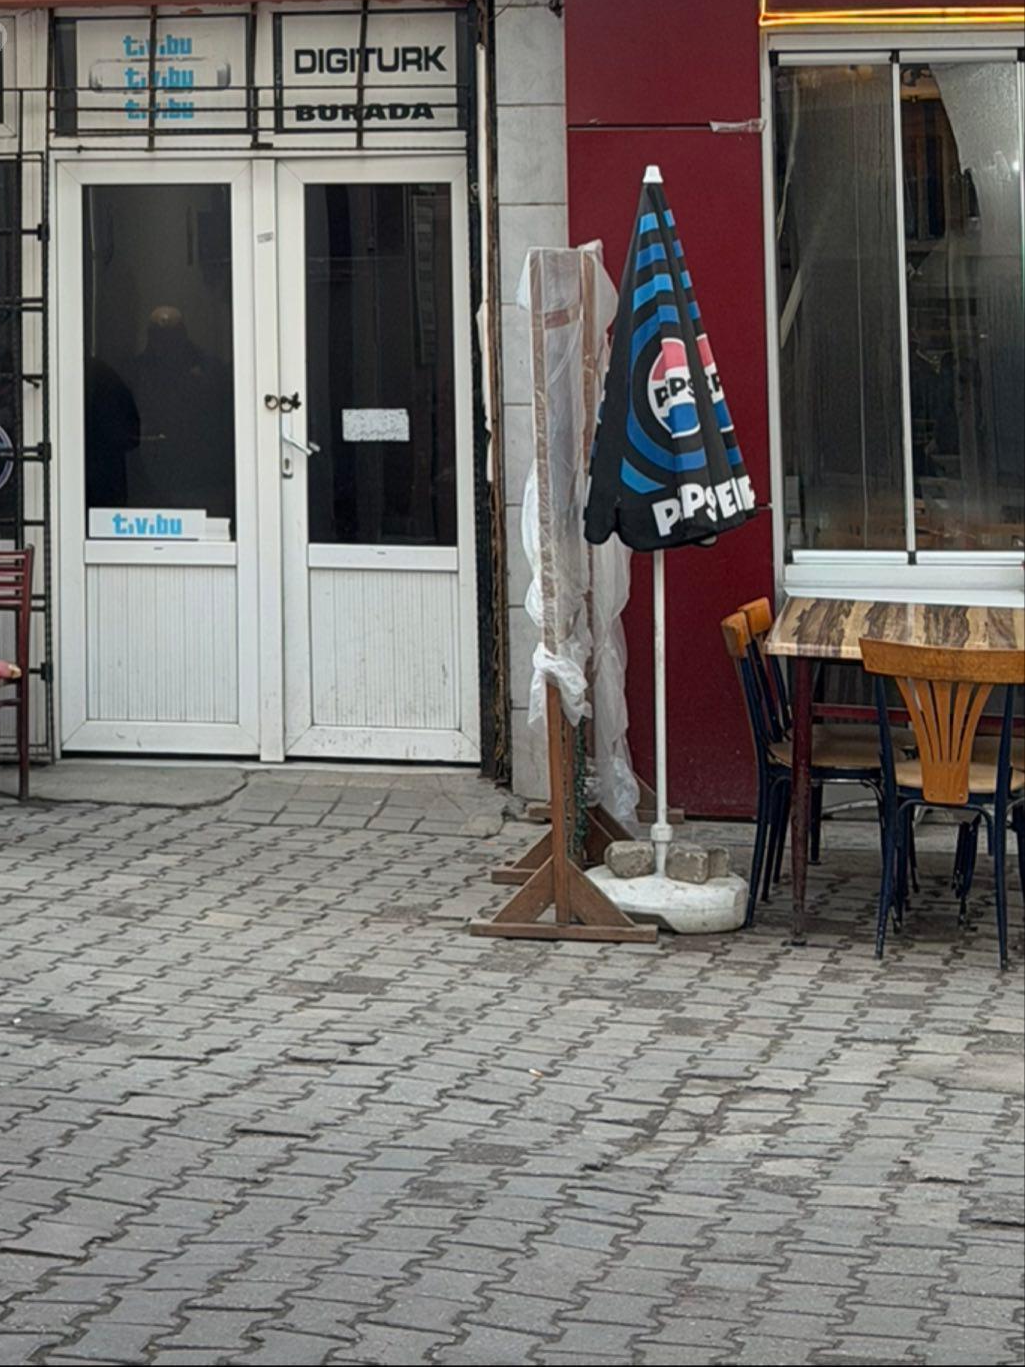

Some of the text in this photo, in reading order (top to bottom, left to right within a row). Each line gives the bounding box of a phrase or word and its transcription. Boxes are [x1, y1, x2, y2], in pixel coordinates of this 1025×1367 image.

[294, 46, 447, 74] DIGITURK
[295, 103, 434, 121] BURADA
[112, 513, 182, 535] tivibu
